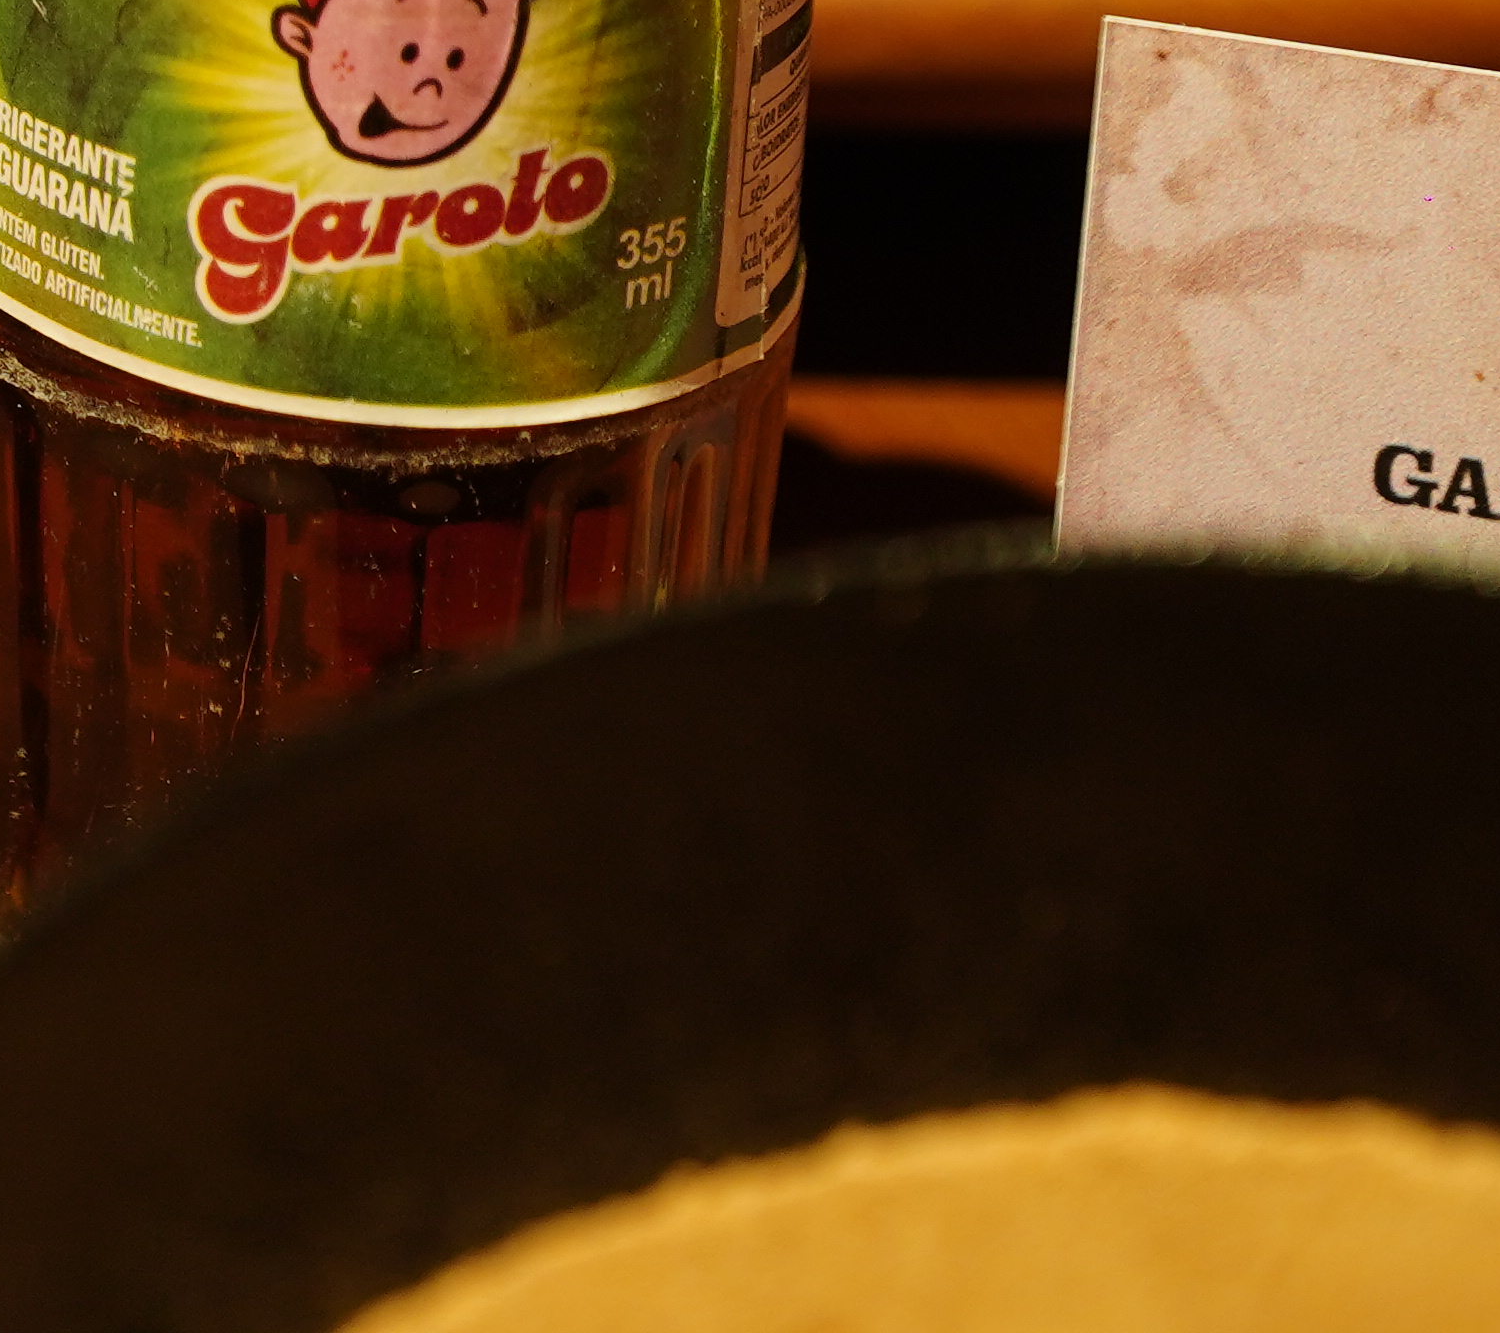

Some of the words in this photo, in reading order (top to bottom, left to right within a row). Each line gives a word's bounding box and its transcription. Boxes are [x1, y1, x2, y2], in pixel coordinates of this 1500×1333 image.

[40, 229, 105, 281] GLÚTEN.
[616, 215, 688, 270] 355
[44, 268, 203, 349] ARTIFICIALMENTE.
[625, 260, 673, 309] ml
